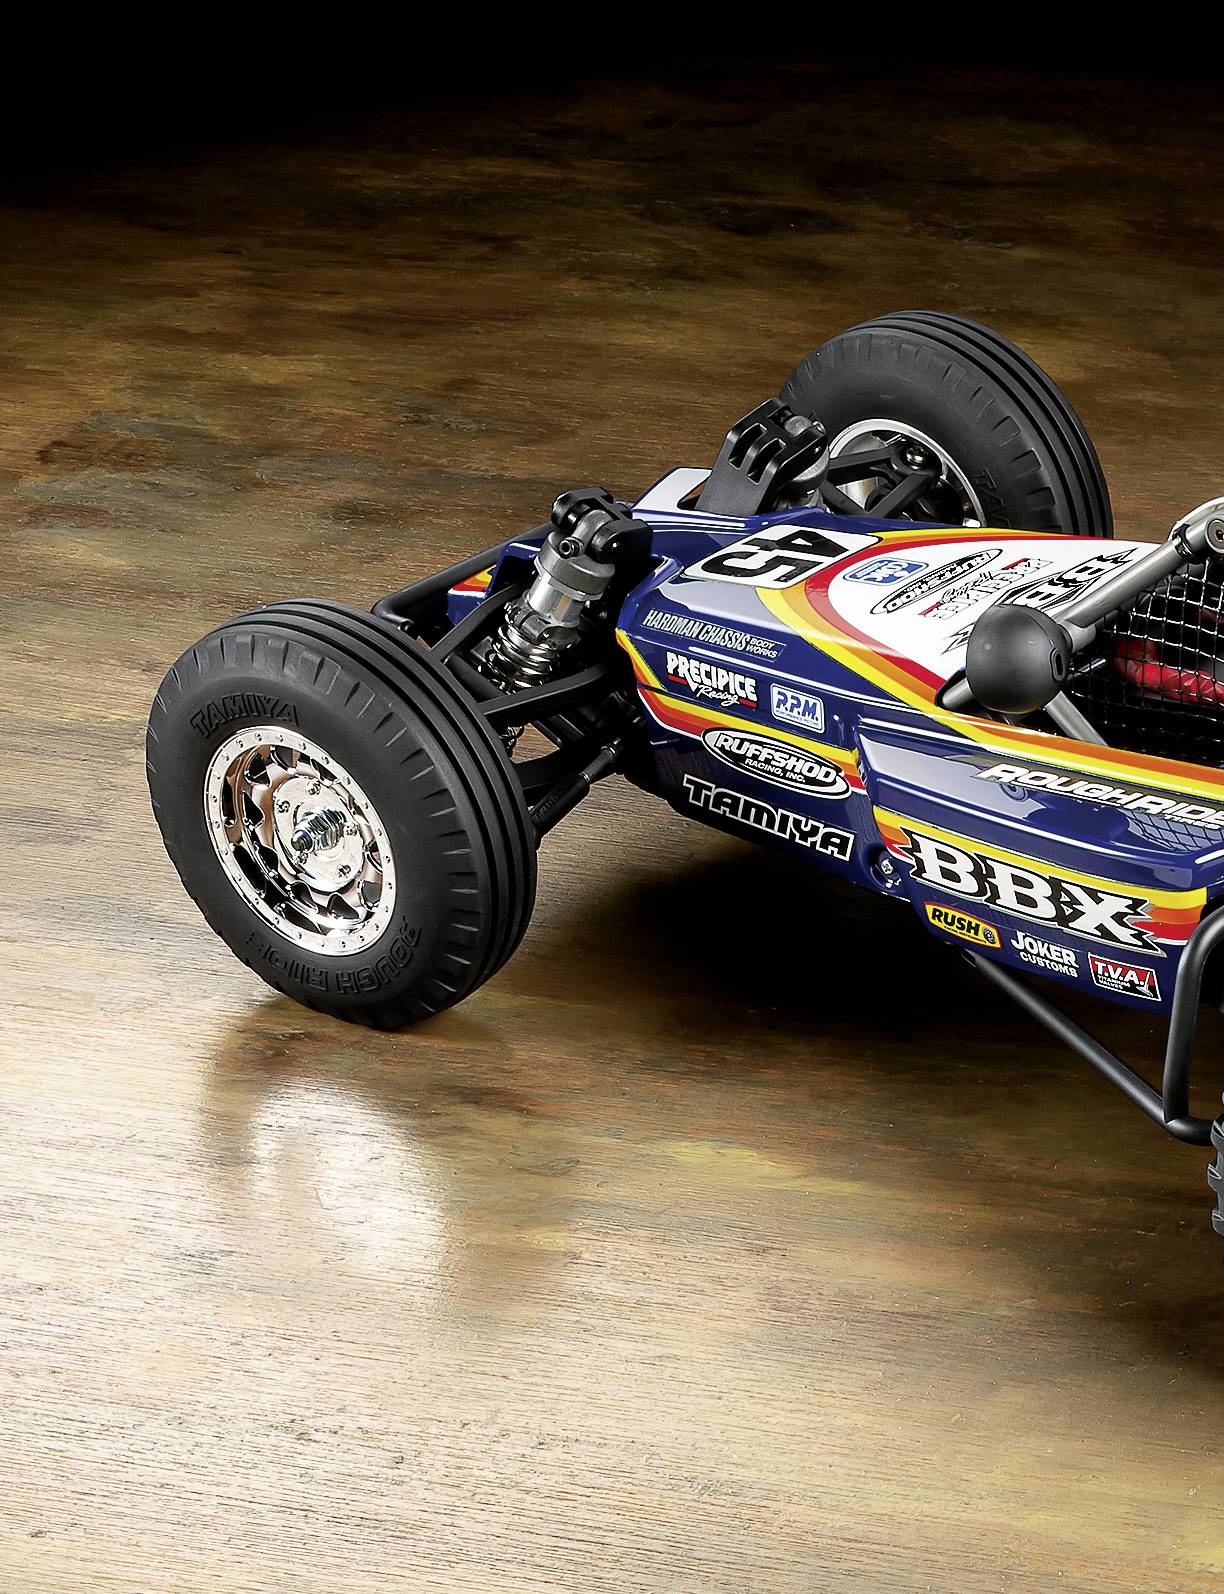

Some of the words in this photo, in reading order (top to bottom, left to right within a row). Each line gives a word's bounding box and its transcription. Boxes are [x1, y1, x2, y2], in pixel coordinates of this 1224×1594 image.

[701, 530, 849, 582] 45
[642, 609, 701, 638] HARDMAN
[699, 623, 751, 651] CHASSIS
[750, 637, 776, 650] BODY
[746, 644, 778, 659] WORKS
[666, 651, 758, 702] PRECIPICE
[696, 684, 740, 707] Racing
[189, 692, 301, 739] TAMIYA
[715, 733, 838, 784] RUFFSHOD
[744, 758, 784, 777] RACING,
[785, 771, 806, 783] INC.
[682, 773, 856, 862] TAMIYA
[900, 827, 1167, 957] BBX
[931, 907, 981, 937] RUSH
[335, 915, 422, 995] ROUGH
[1010, 930, 1080, 968] JOKER
[1019, 951, 1079, 978] CUSTOMS
[1094, 960, 1145, 985] T.V.A.
